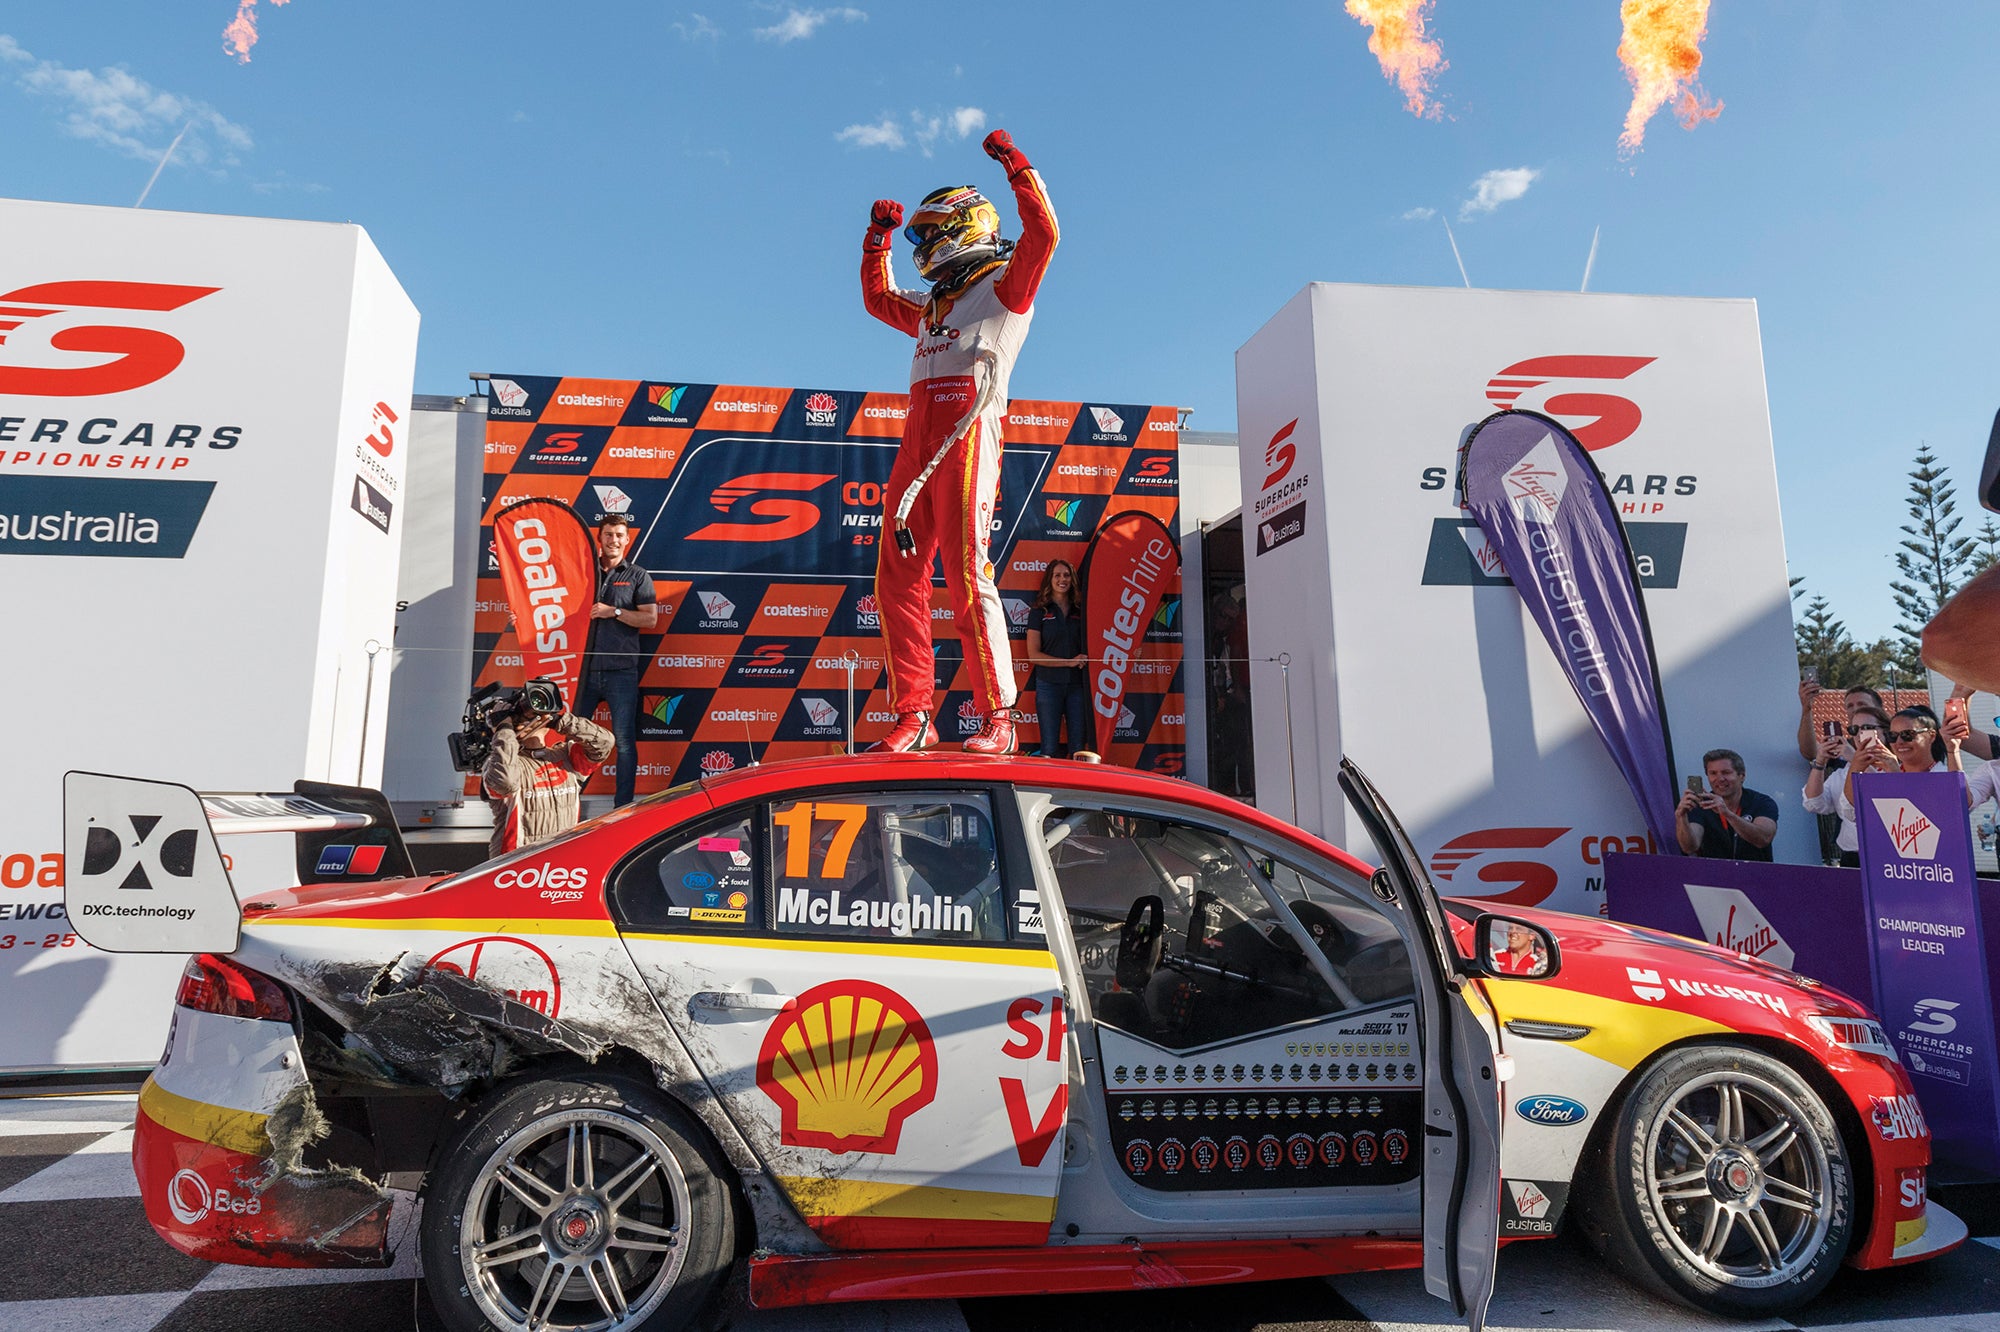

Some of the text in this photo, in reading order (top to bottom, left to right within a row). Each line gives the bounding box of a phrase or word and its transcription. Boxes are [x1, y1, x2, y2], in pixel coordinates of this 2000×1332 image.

[499, 384, 523, 404] Virgin
[557, 394, 624, 407] coateshire
[934, 393, 968, 402] GROVE
[490, 407, 531, 416] australia
[713, 400, 778, 414] coateshire
[647, 415, 688, 423] visitnsw.com
[805, 411, 836, 423] NSW
[1009, 414, 1069, 427] coateshire
[1092, 432, 1128, 442] australia
[529, 454, 588, 462] SUPERCARS
[609, 445, 675, 460] coateshire
[1057, 464, 1118, 477] coateshire
[1255, 474, 1309, 513] SUPERCARS
[1509, 463, 1559, 512] Virgin
[602, 490, 627, 510] Virgin
[1261, 492, 1302, 519] CHAMPIONSHIP
[1274, 519, 1300, 542] australia
[706, 595, 731, 617] Virgin
[764, 604, 828, 617] coateshire
[1530, 529, 1611, 697] australia
[699, 620, 738, 628] australia
[1094, 538, 1172, 718] coateshire
[658, 655, 726, 668] coateshire
[710, 709, 778, 722] coateshire
[811, 702, 833, 723] Virgin
[642, 727, 684, 736] visitnsw.com
[803, 726, 842, 735] australia
[1891, 807, 1931, 854] Virgin
[774, 802, 868, 879] 17
[318, 862, 344, 871] mtu
[1883, 862, 1954, 883] australia
[494, 863, 588, 890] coles
[540, 888, 584, 901] express
[82, 904, 196, 920] DXC.technology
[701, 911, 742, 919] DUNLOP
[778, 888, 972, 937] McLaughlin
[1879, 917, 1966, 939] CHAMPIONSHIP
[1901, 938, 1945, 955] LEADER
[1667, 978, 1792, 1018] WÜRTH
[1397, 1023, 1408, 1035] 17
[1898, 1031, 1973, 1055] SUPERCARS
[1908, 1043, 1964, 1059] CHAMPIONSHIP
[1926, 1063, 1961, 1080] australia
[1530, 1099, 1575, 1122] Ford
[1631, 1118, 1669, 1252] DUNLOP
[1517, 1187, 1545, 1215] Virgin
[1506, 1219, 1552, 1232] australia
